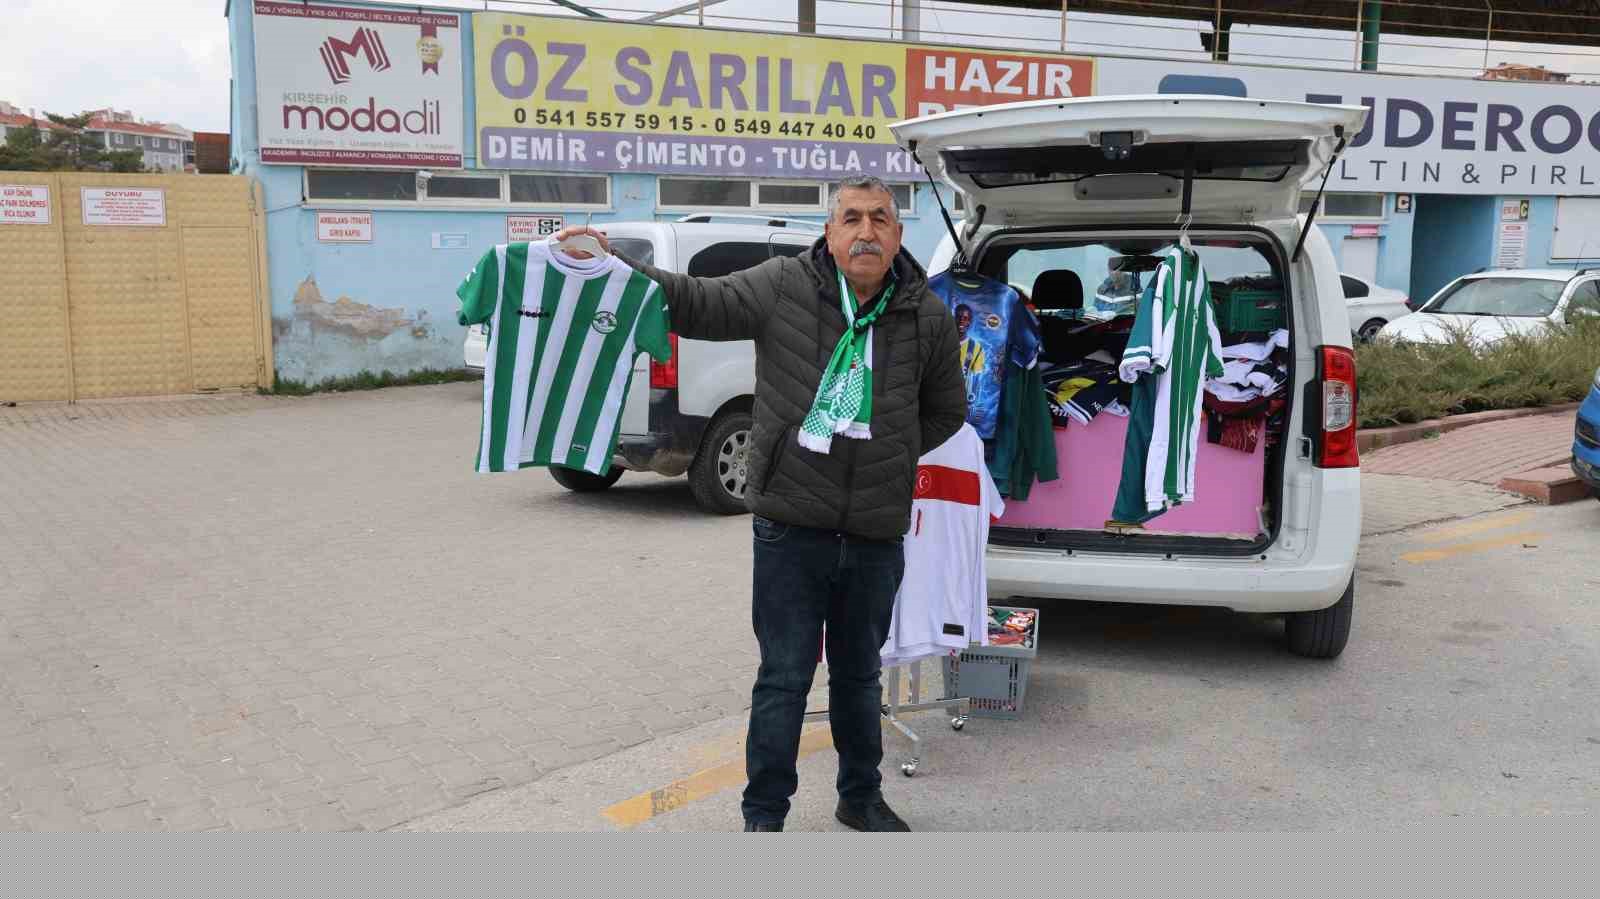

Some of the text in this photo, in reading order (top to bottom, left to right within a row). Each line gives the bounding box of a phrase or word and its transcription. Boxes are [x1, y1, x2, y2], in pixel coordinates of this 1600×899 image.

[490, 24, 898, 119] ÖZ SARILAR
[924, 56, 1073, 97] HAZIR
[283, 92, 347, 105] KIRŞEHİR
[283, 96, 440, 135] modadil
[514, 107, 527, 124] 0
[535, 109, 575, 127] 541
[586, 111, 626, 128] 557
[635, 113, 660, 130] 59
[669, 115, 694, 131] 15
[714, 117, 726, 133] 0
[734, 118, 772, 134] 549
[778, 120, 815, 136] 447
[822, 122, 846, 138] 40
[853, 124, 876, 139] 40
[488, 131, 588, 162] DEMİR
[615, 135, 746, 169] ÇİMENTO
[772, 143, 862, 172] TUĞLA
[1321, 159, 1440, 183] LTIN
[1461, 162, 1480, 184] &
